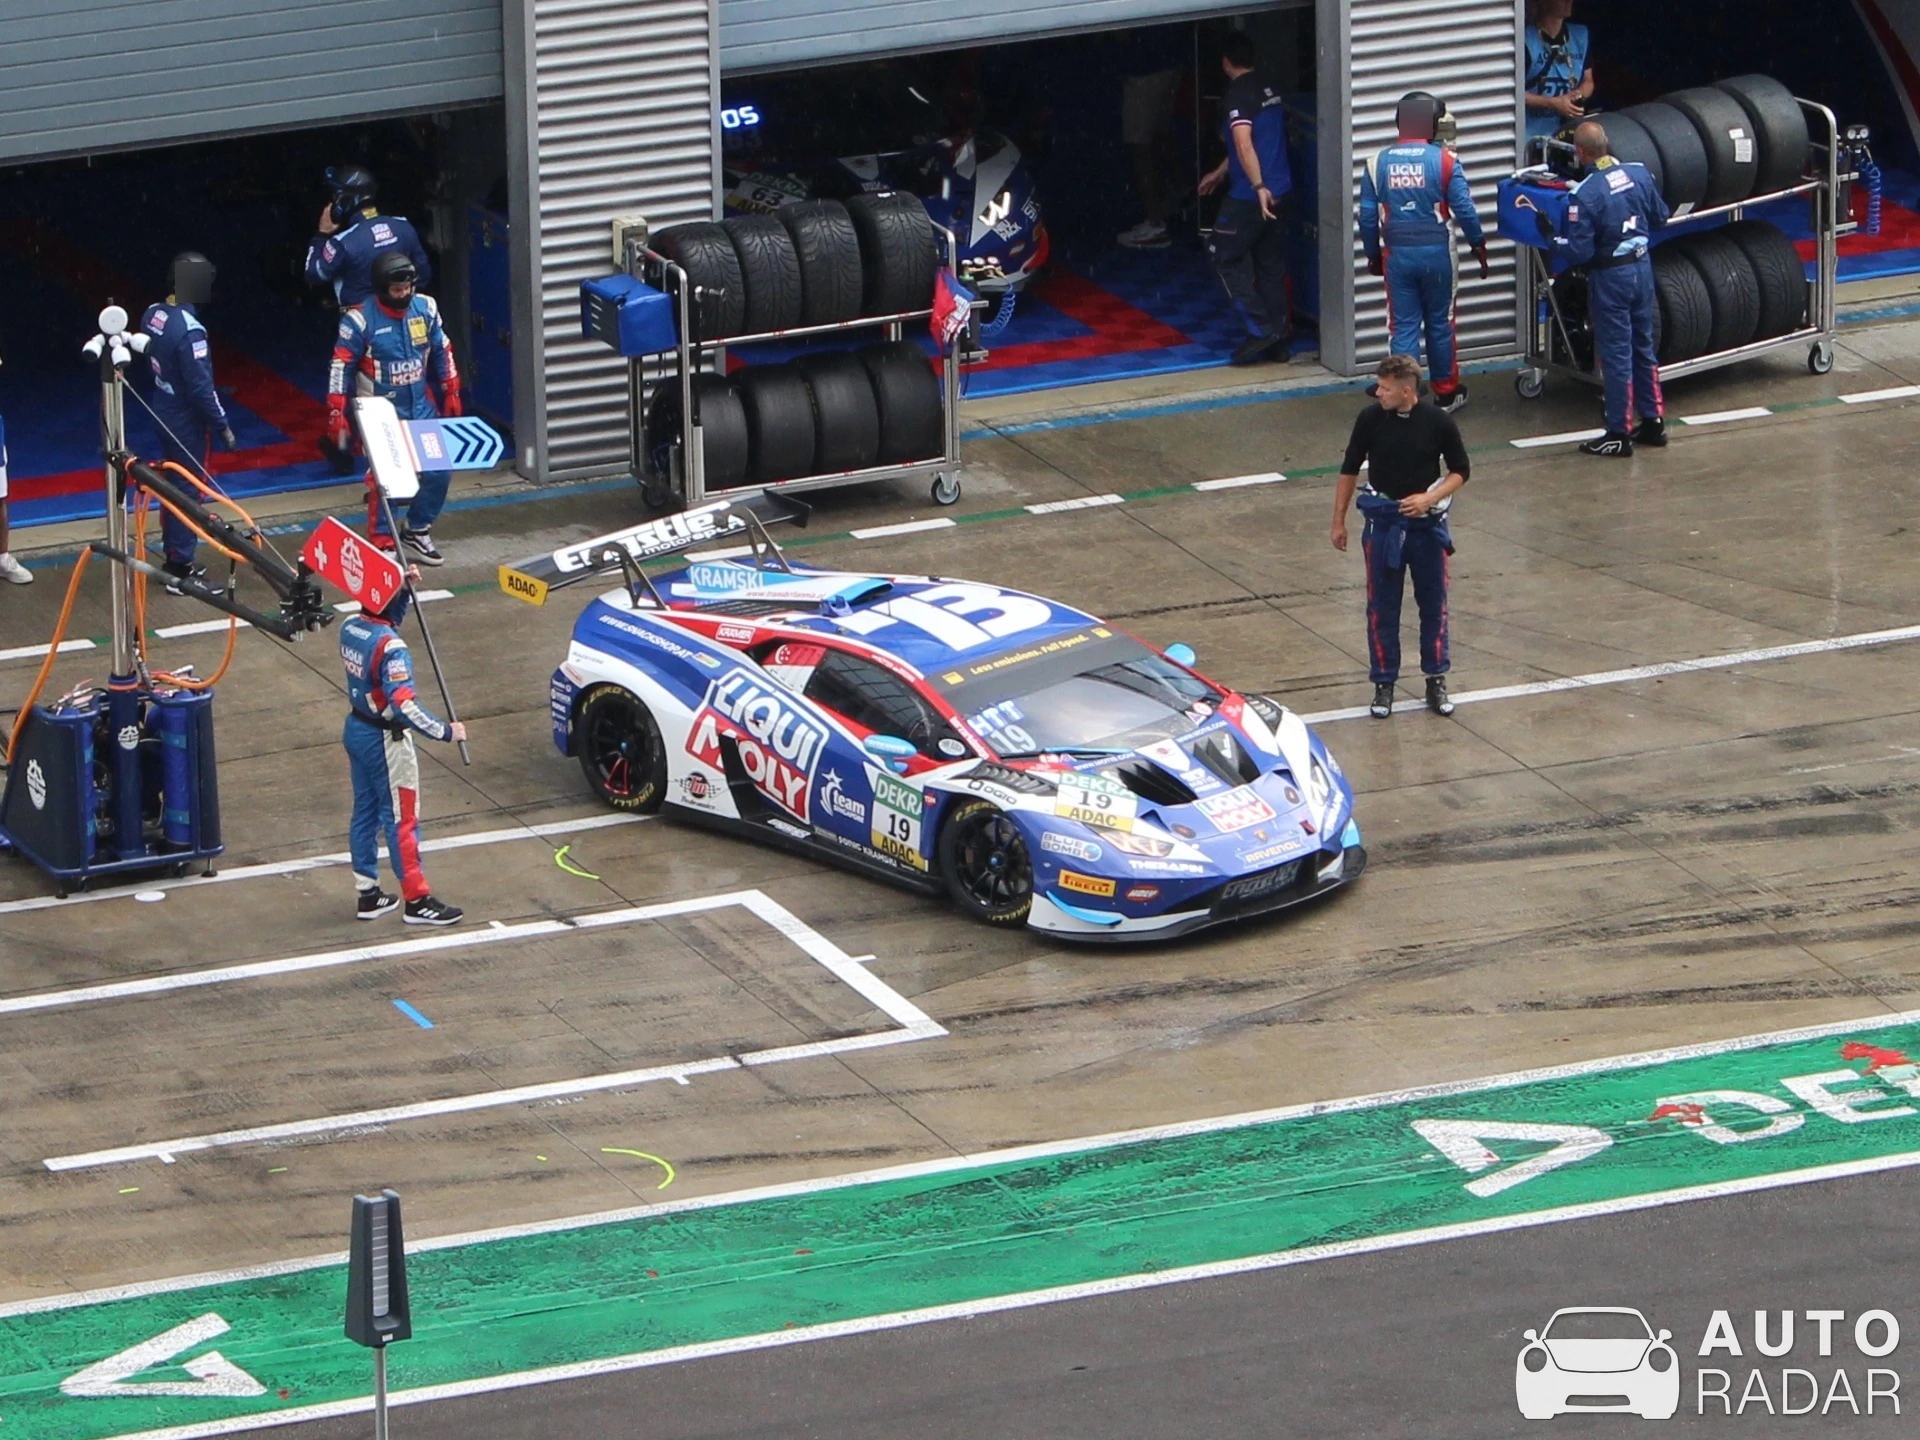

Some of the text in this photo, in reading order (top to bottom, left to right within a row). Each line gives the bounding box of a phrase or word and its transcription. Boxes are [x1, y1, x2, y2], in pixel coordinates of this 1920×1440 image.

[1390, 165, 1422, 176] LIQUI
[1391, 176, 1424, 187] MOLY
[391, 359, 422, 374] LIQUI
[392, 369, 423, 386] MOLY
[507, 575, 537, 595] ADAC
[690, 566, 764, 590] KRAMSKI
[713, 676, 818, 772] LIQUI
[990, 724, 1037, 753] 19
[692, 714, 806, 810] MOLY
[876, 778, 922, 816] DEKRA
[983, 785, 1017, 805] OGIO
[1061, 772, 1138, 800] DEKRA
[834, 789, 865, 816] team
[1079, 790, 1112, 810] 19
[1198, 788, 1257, 815] LIQUI
[1069, 807, 1117, 827] ADAC
[1212, 801, 1269, 831] MOLY
[888, 813, 911, 842] 19
[881, 836, 914, 864] ADAC
[1042, 842, 1082, 856] BOMB
[1044, 833, 1083, 847] BLUE
[1063, 874, 1111, 894] PIRELLI
